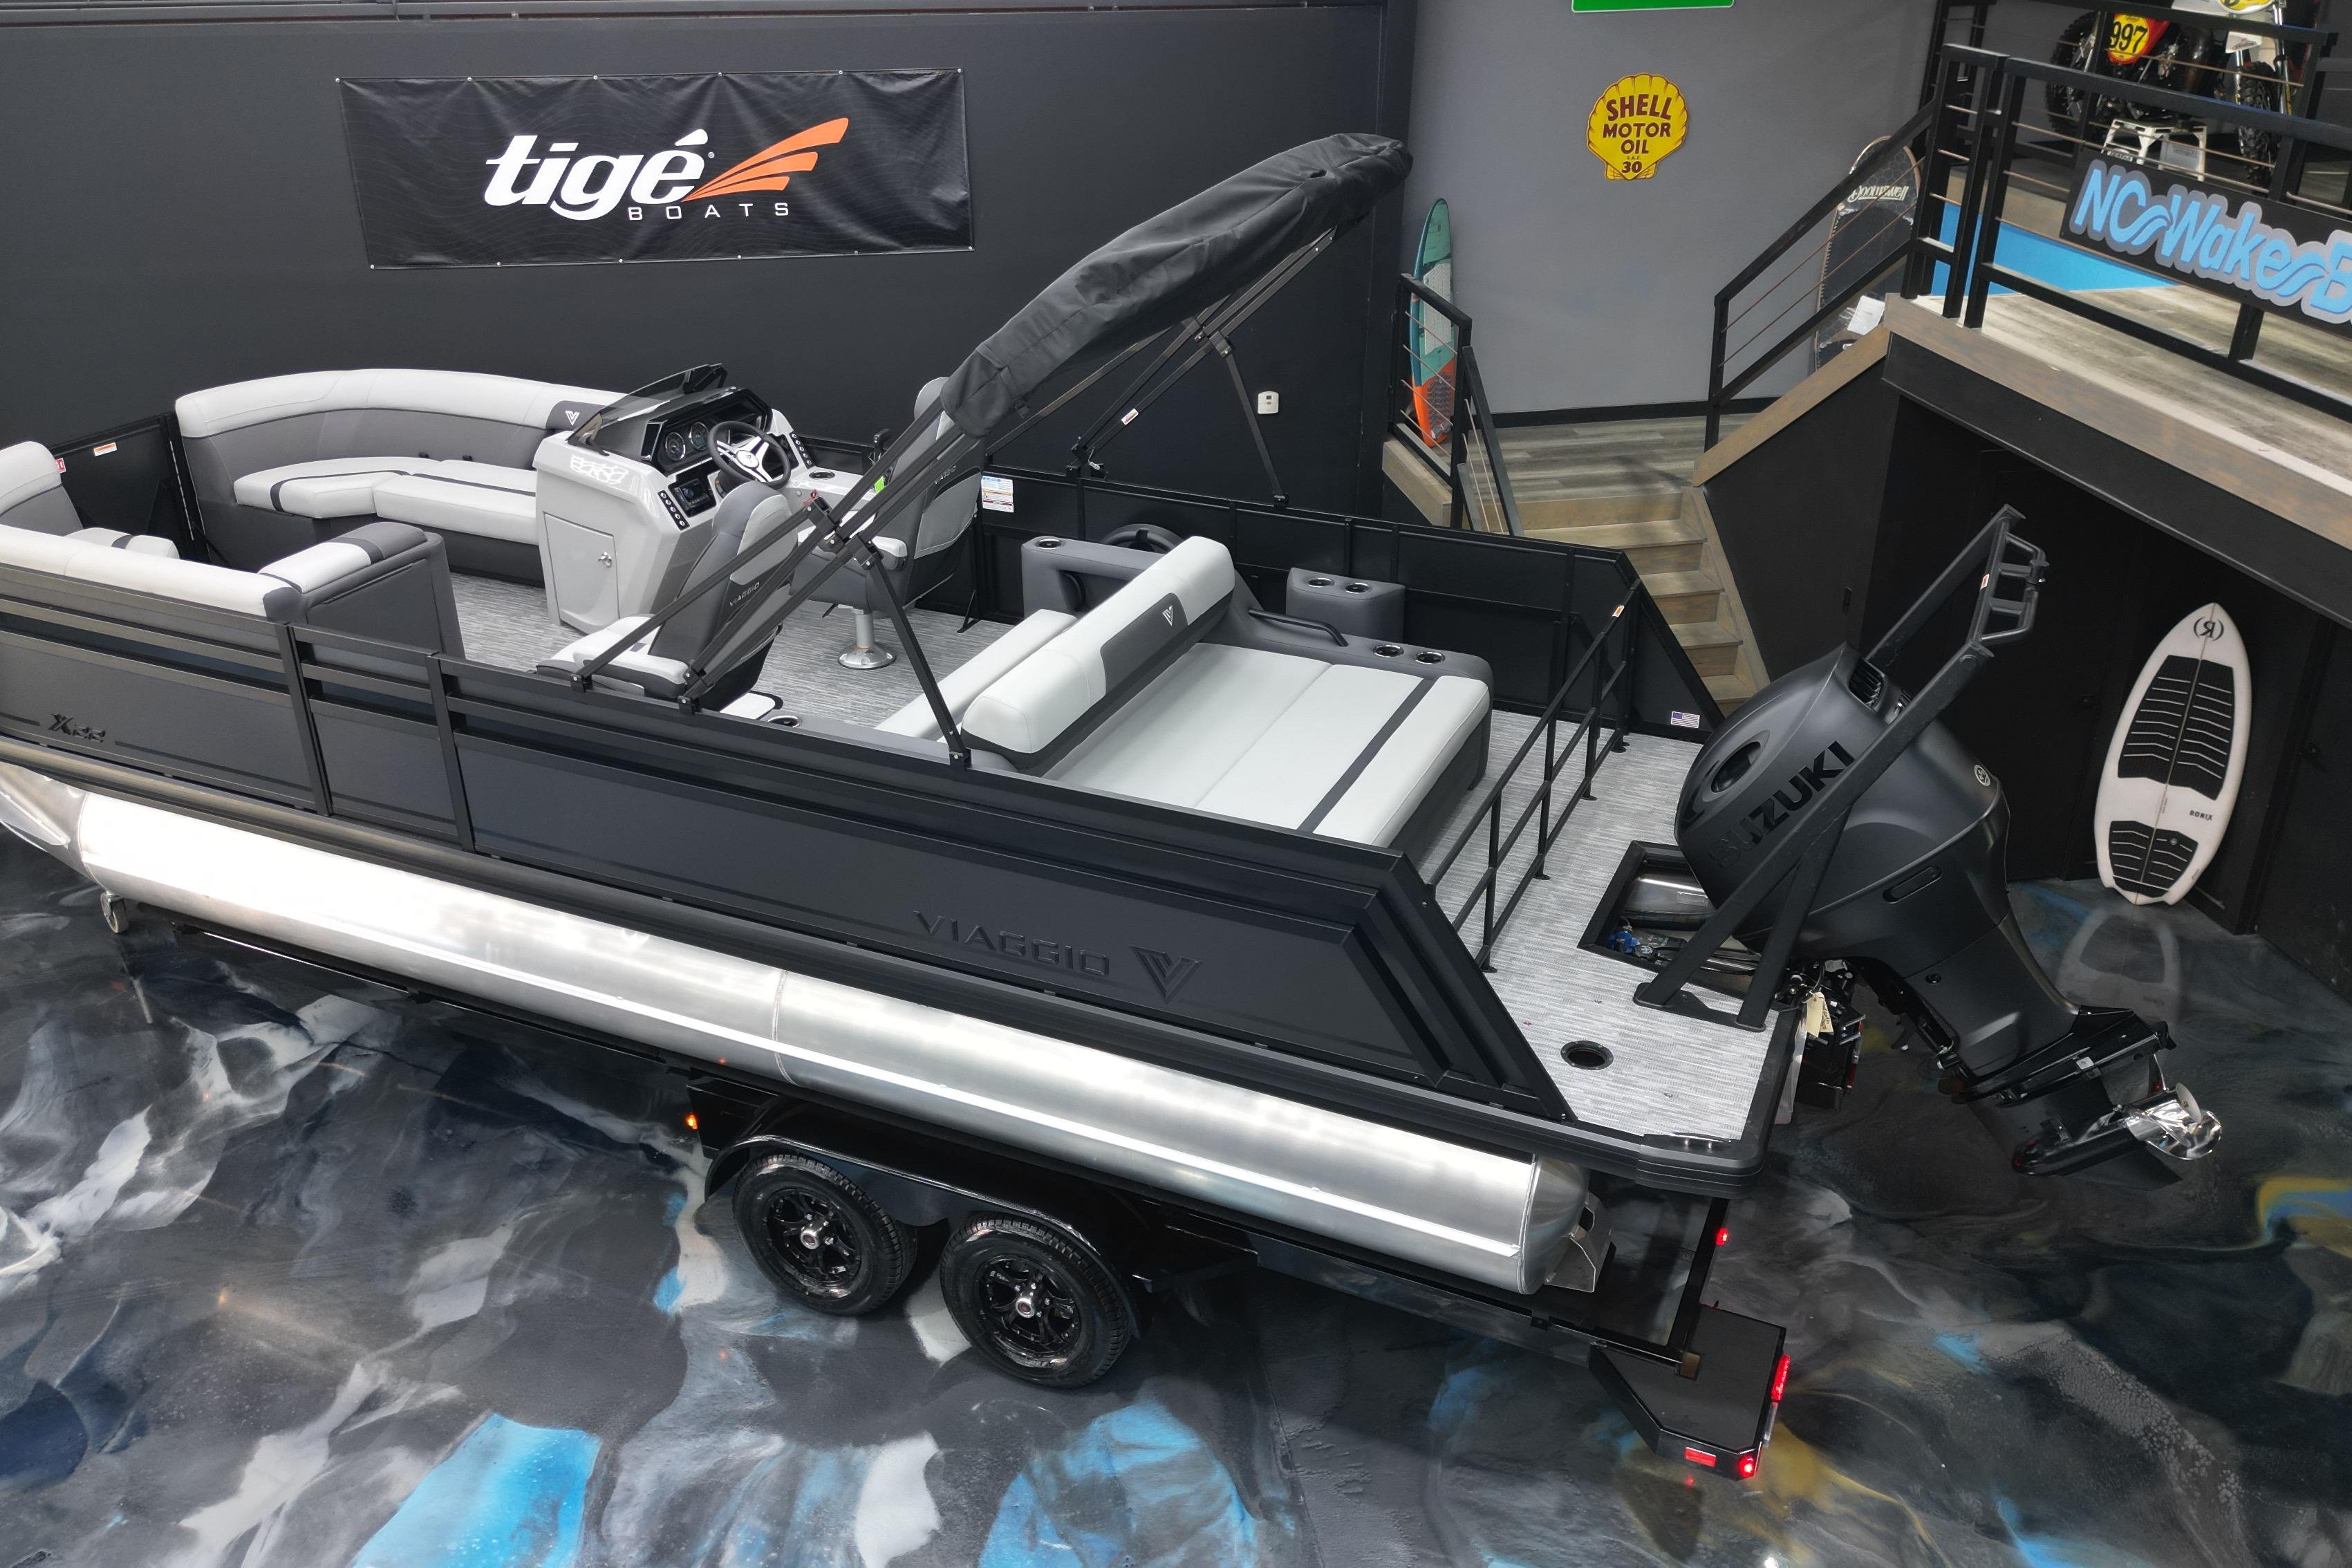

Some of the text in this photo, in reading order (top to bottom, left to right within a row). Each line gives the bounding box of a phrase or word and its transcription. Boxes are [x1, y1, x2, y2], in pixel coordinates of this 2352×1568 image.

[1606, 93, 1672, 122] SHELL
[1603, 122, 1672, 139] MOTOR
[1621, 139, 1650, 154] OIL
[1621, 160, 1643, 174] 30
[628, 202, 790, 221] BOATS
[1709, 740, 1856, 868] SUZUKI
[912, 908, 1110, 976] VIAGGIO
